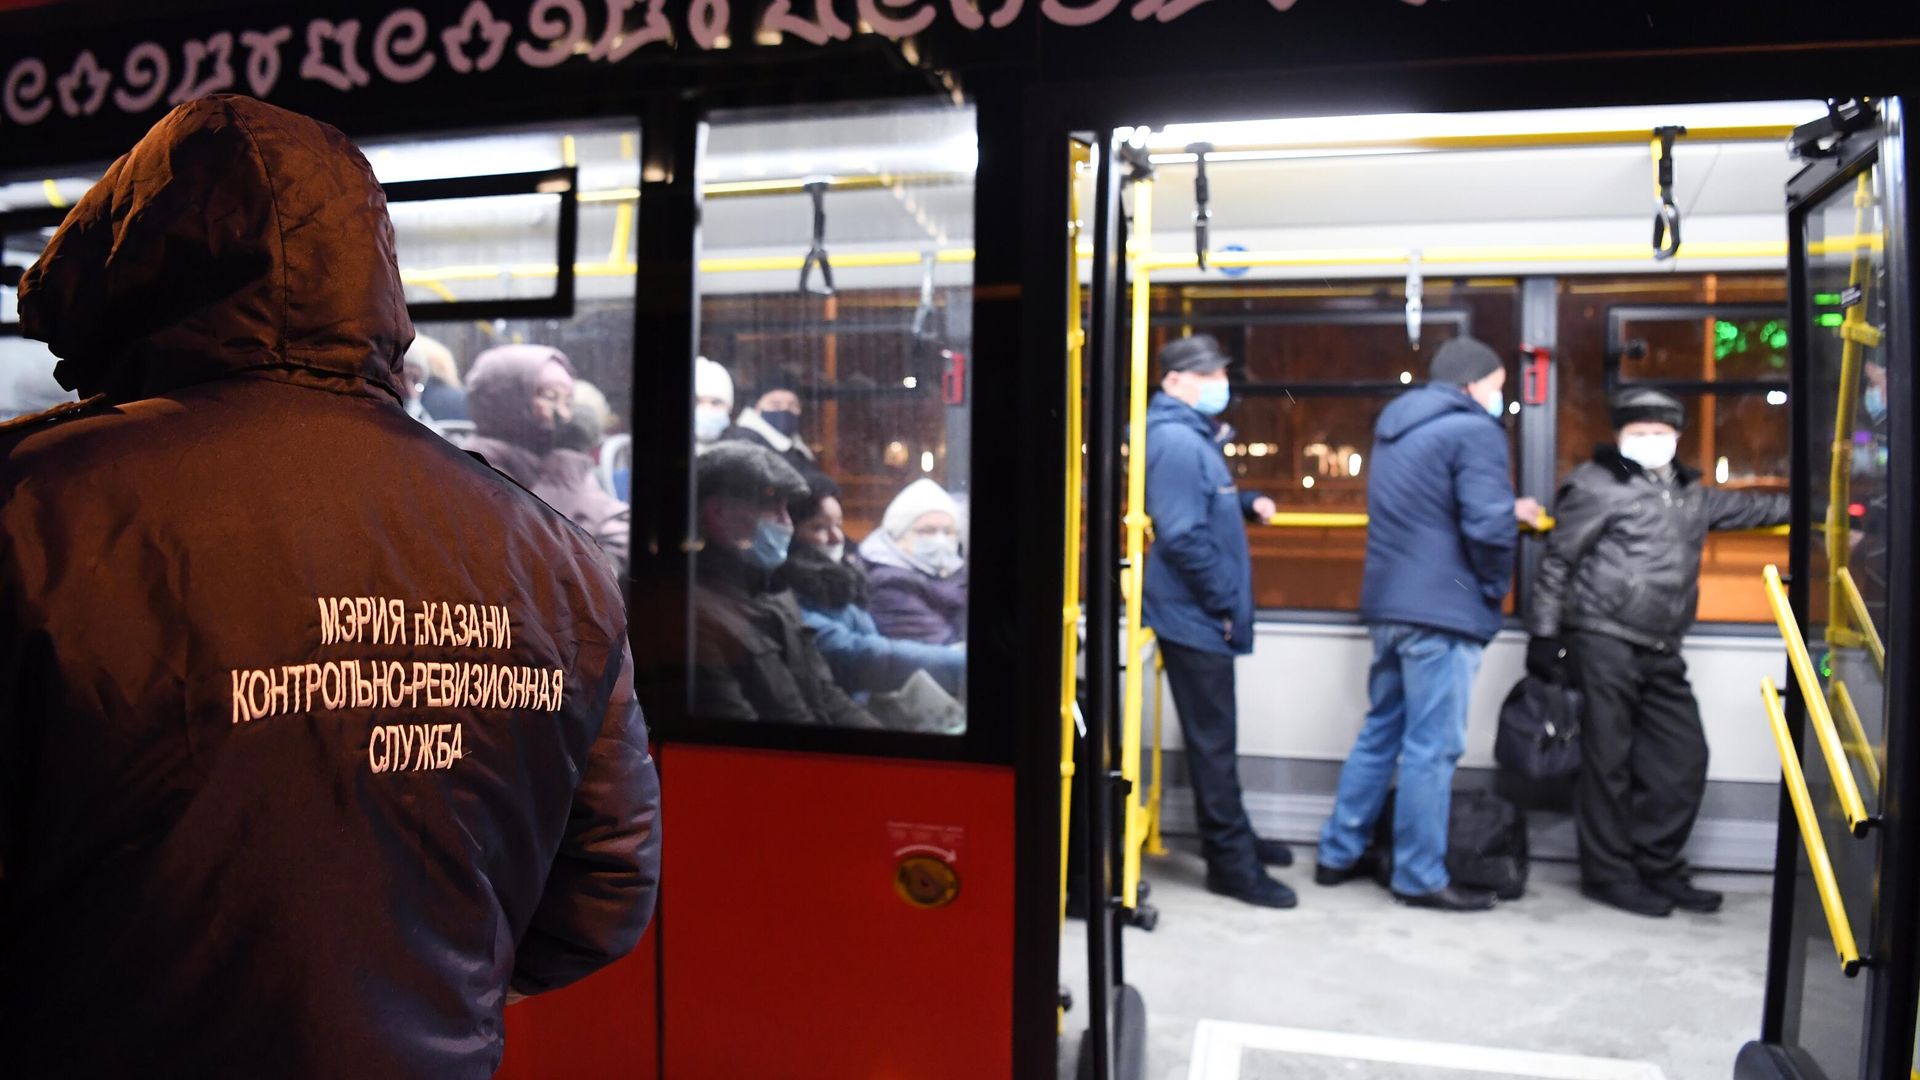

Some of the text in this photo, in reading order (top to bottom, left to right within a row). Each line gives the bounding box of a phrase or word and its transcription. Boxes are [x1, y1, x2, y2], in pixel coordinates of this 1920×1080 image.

[317, 596, 407, 645] МЭРИЯ
[231, 659, 563, 723] КОНТРОЛЬНО-РЕВИЗИОННАЯ
[368, 723, 463, 774] СЛУЖБА
